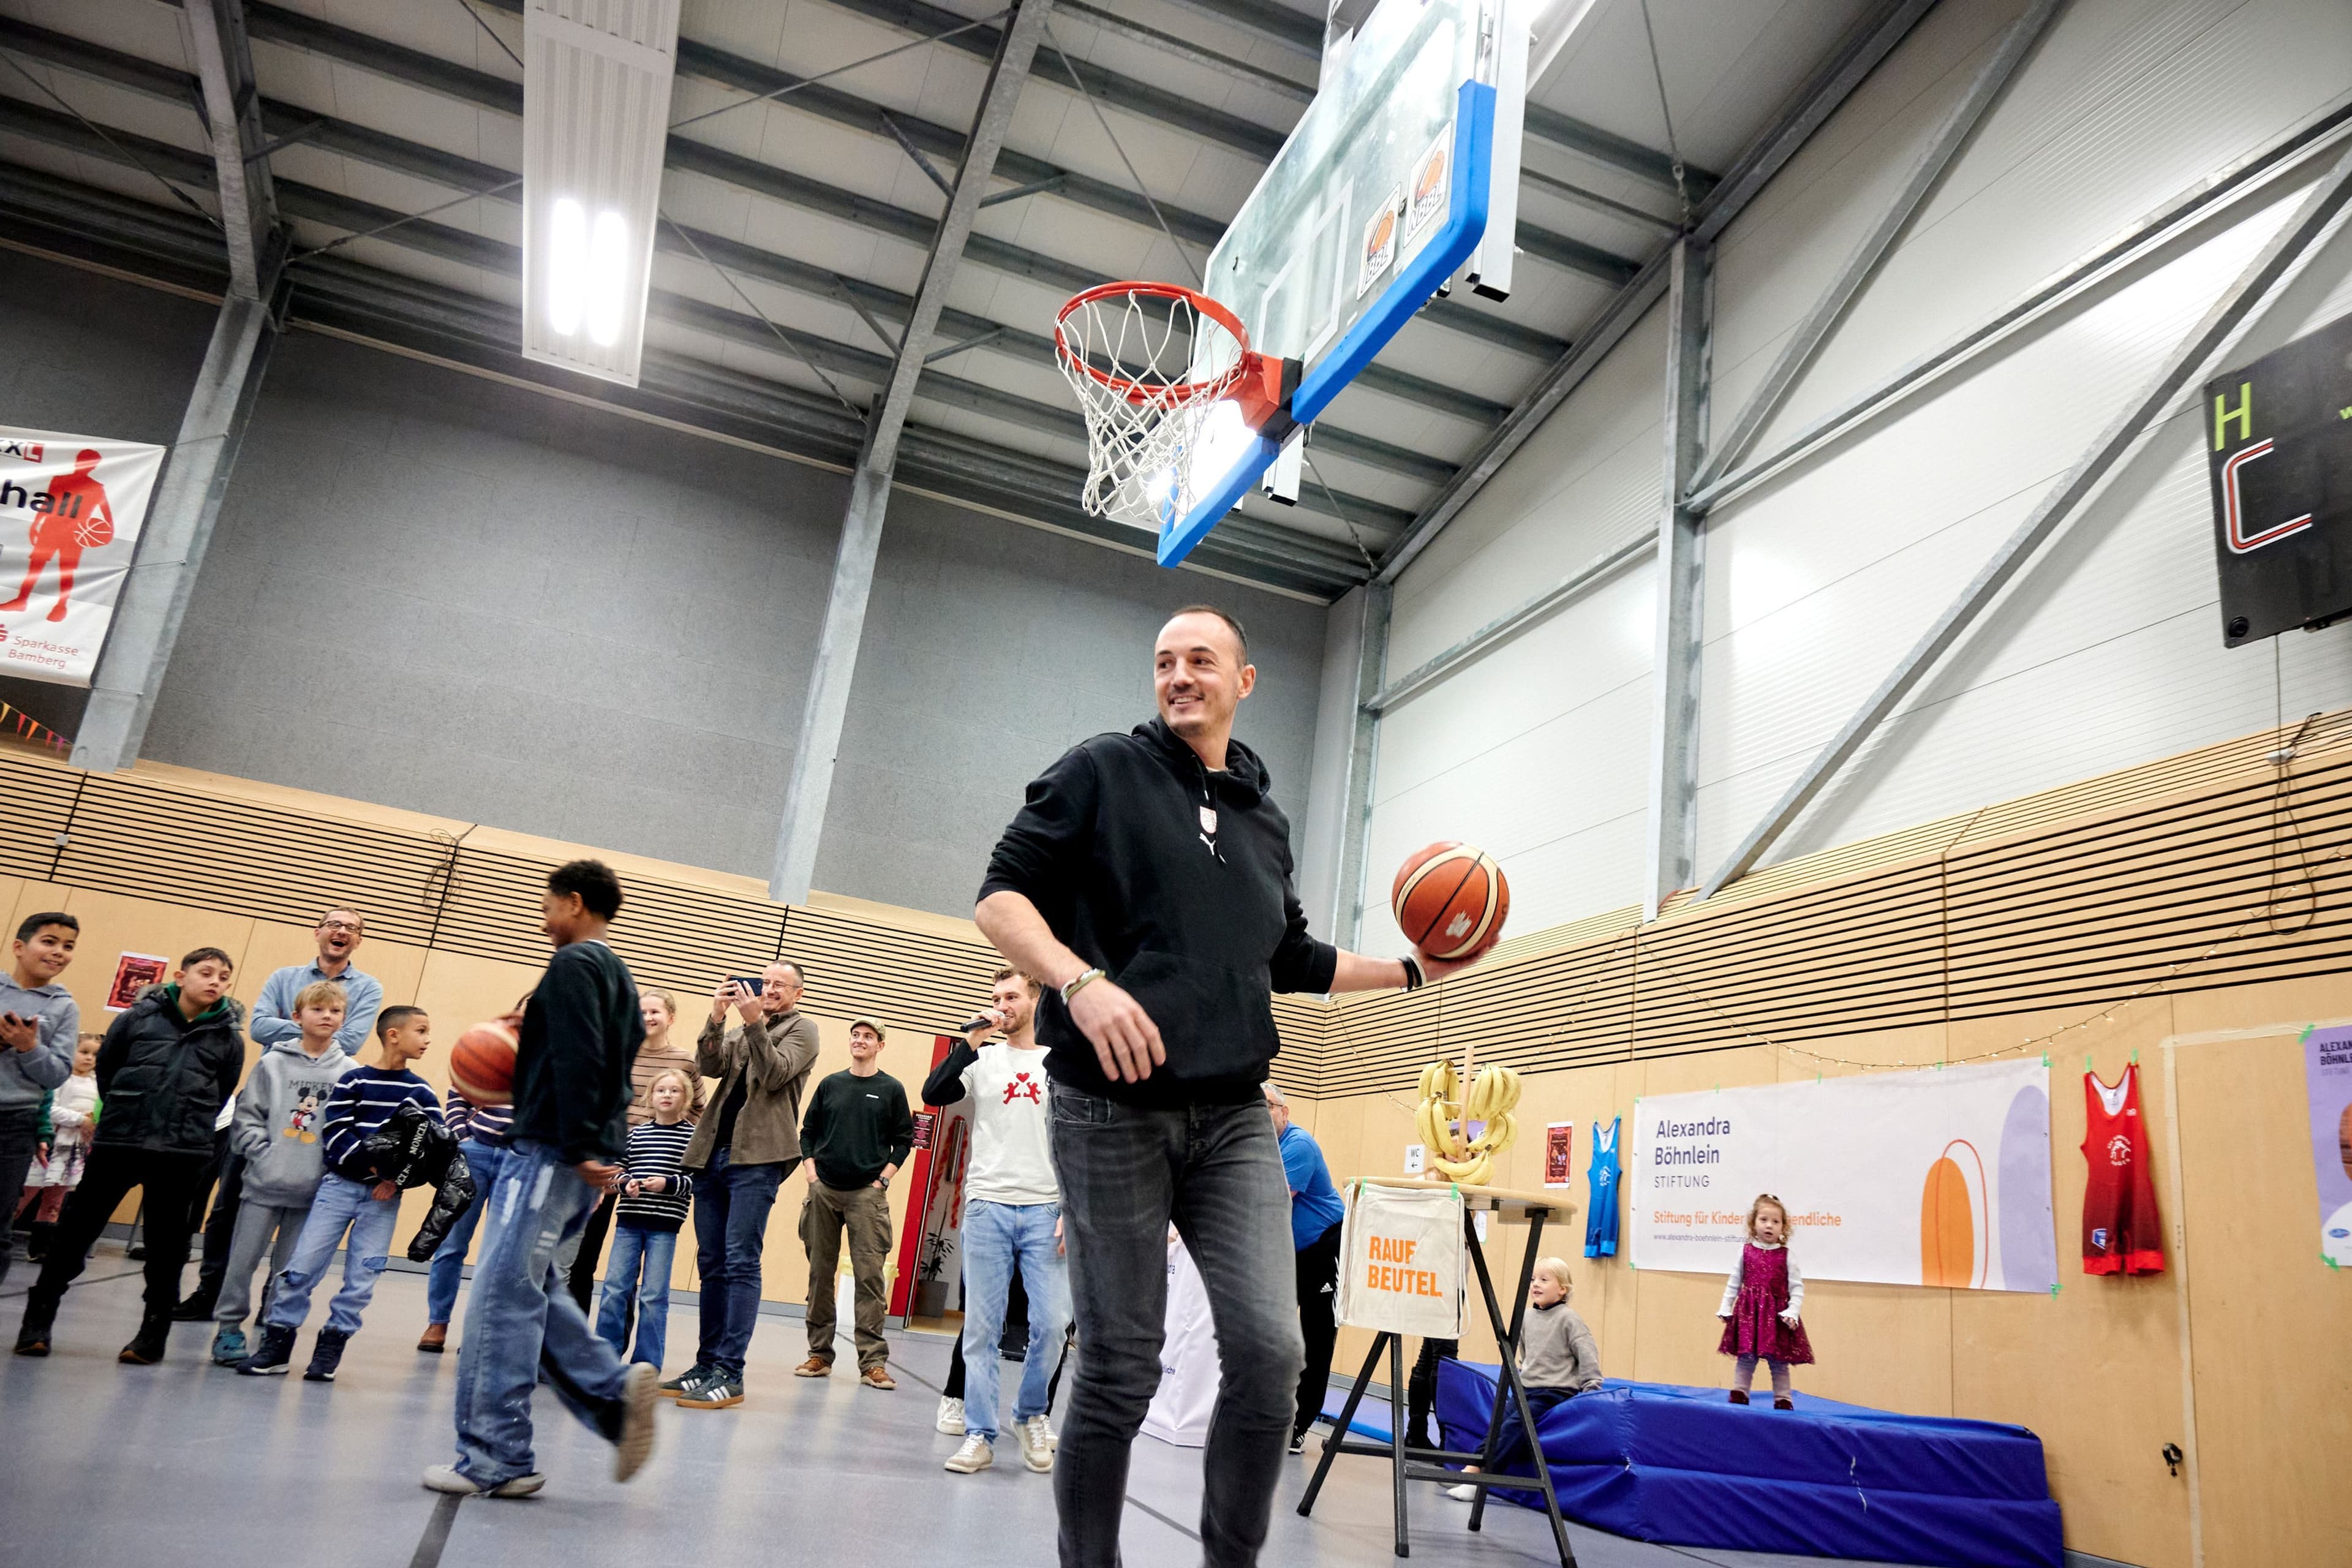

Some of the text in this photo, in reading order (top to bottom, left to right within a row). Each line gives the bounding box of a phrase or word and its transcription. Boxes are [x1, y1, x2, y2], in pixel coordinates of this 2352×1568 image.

[1407, 180, 1442, 236] NBBL
[1360, 241, 1389, 293] JBBL
[2215, 382, 2251, 451] H
[0, 479, 83, 519] hall
[13, 636, 79, 656] Sparkasse
[8, 649, 66, 669] Bamberg
[409, 1120, 429, 1155] MONCLE
[1656, 1117, 1731, 1138] Alexandra
[1411, 1148, 1420, 1157] WC
[1655, 1144, 1720, 1166] Böhnlein
[1654, 1175, 1710, 1188] STIFTUNG
[1654, 1210, 1692, 1227] Stiftung
[1694, 1211, 1709, 1224] für
[1711, 1212, 1745, 1225] Kinder
[1369, 1235, 1416, 1264] RAUF
[1367, 1264, 1442, 1297] BEUTEL
